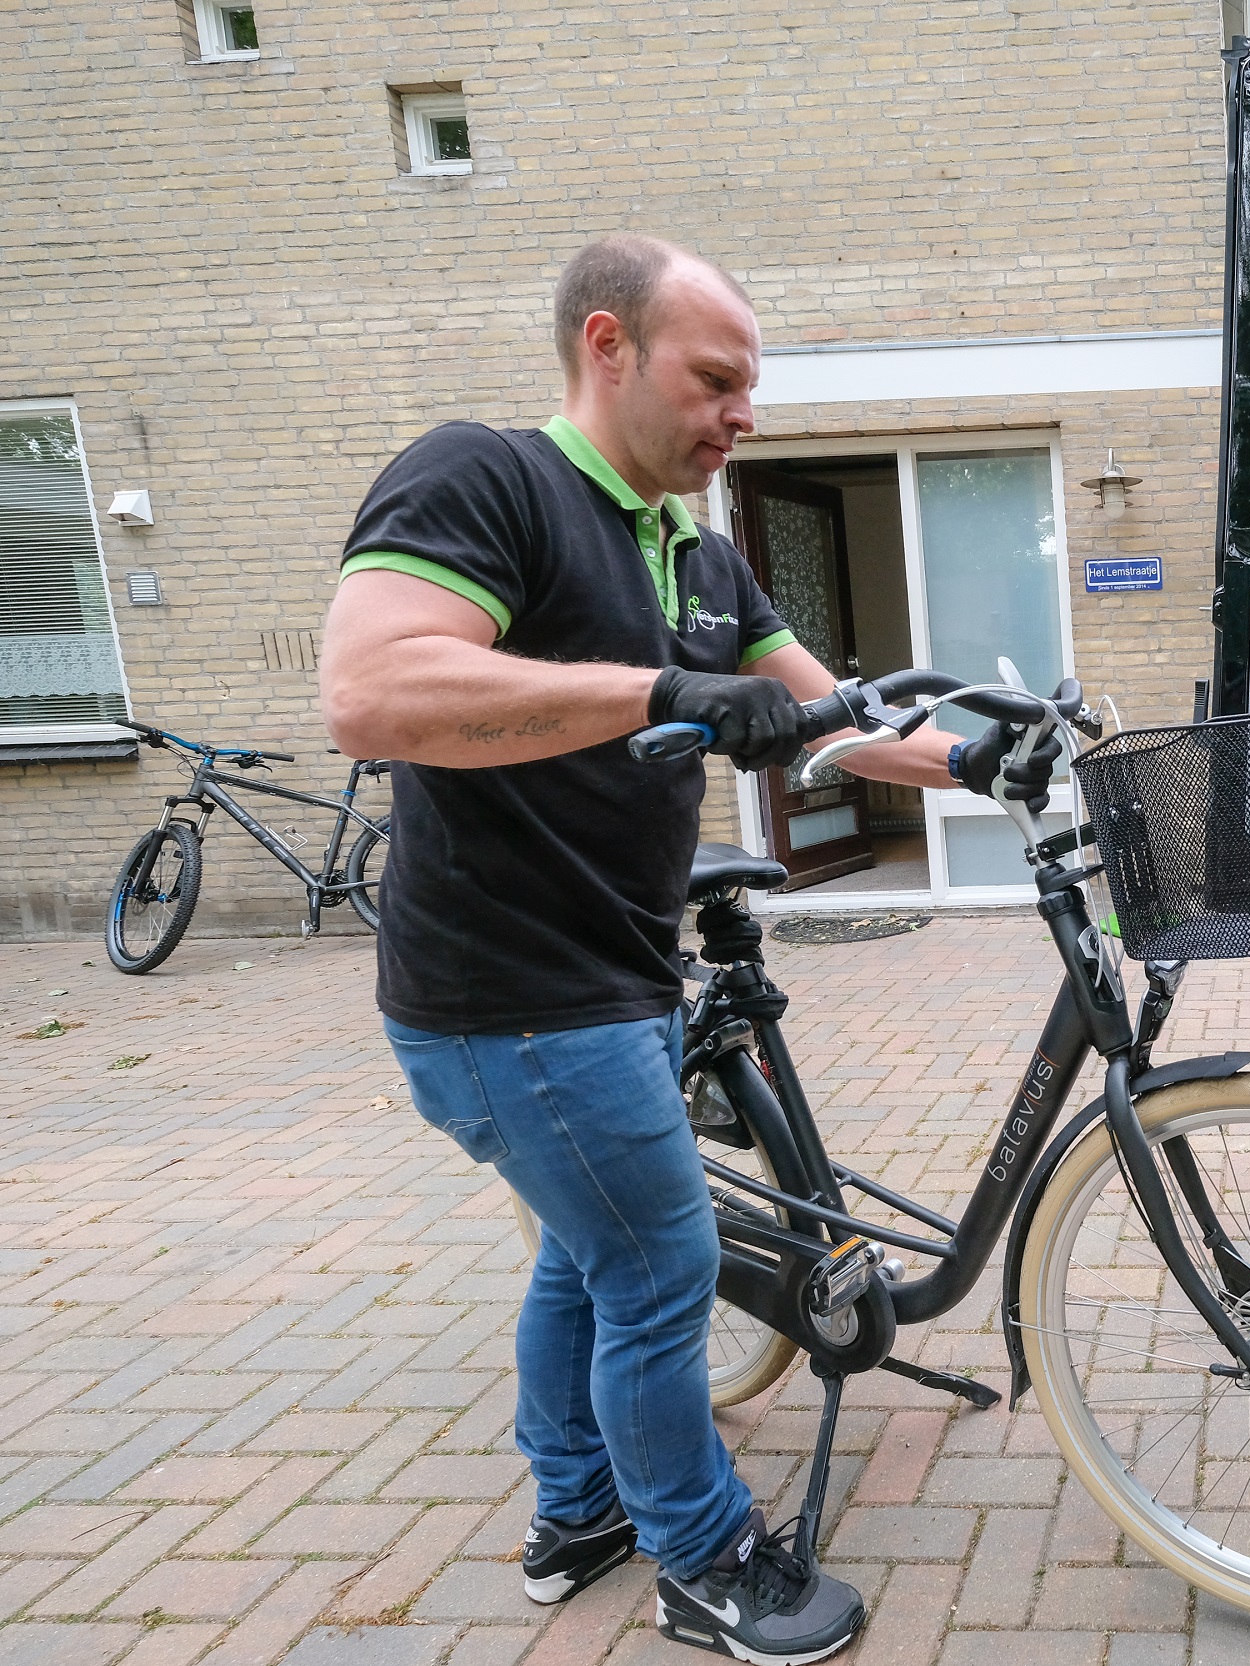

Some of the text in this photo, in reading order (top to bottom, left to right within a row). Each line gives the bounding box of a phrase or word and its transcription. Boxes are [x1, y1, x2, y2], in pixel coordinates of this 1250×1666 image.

[1089, 565, 1156, 578] Het Lemstraatje
[515, 716, 567, 737] Luca
[987, 1060, 1054, 1183] batavus
[736, 1529, 755, 1555] NIKE
